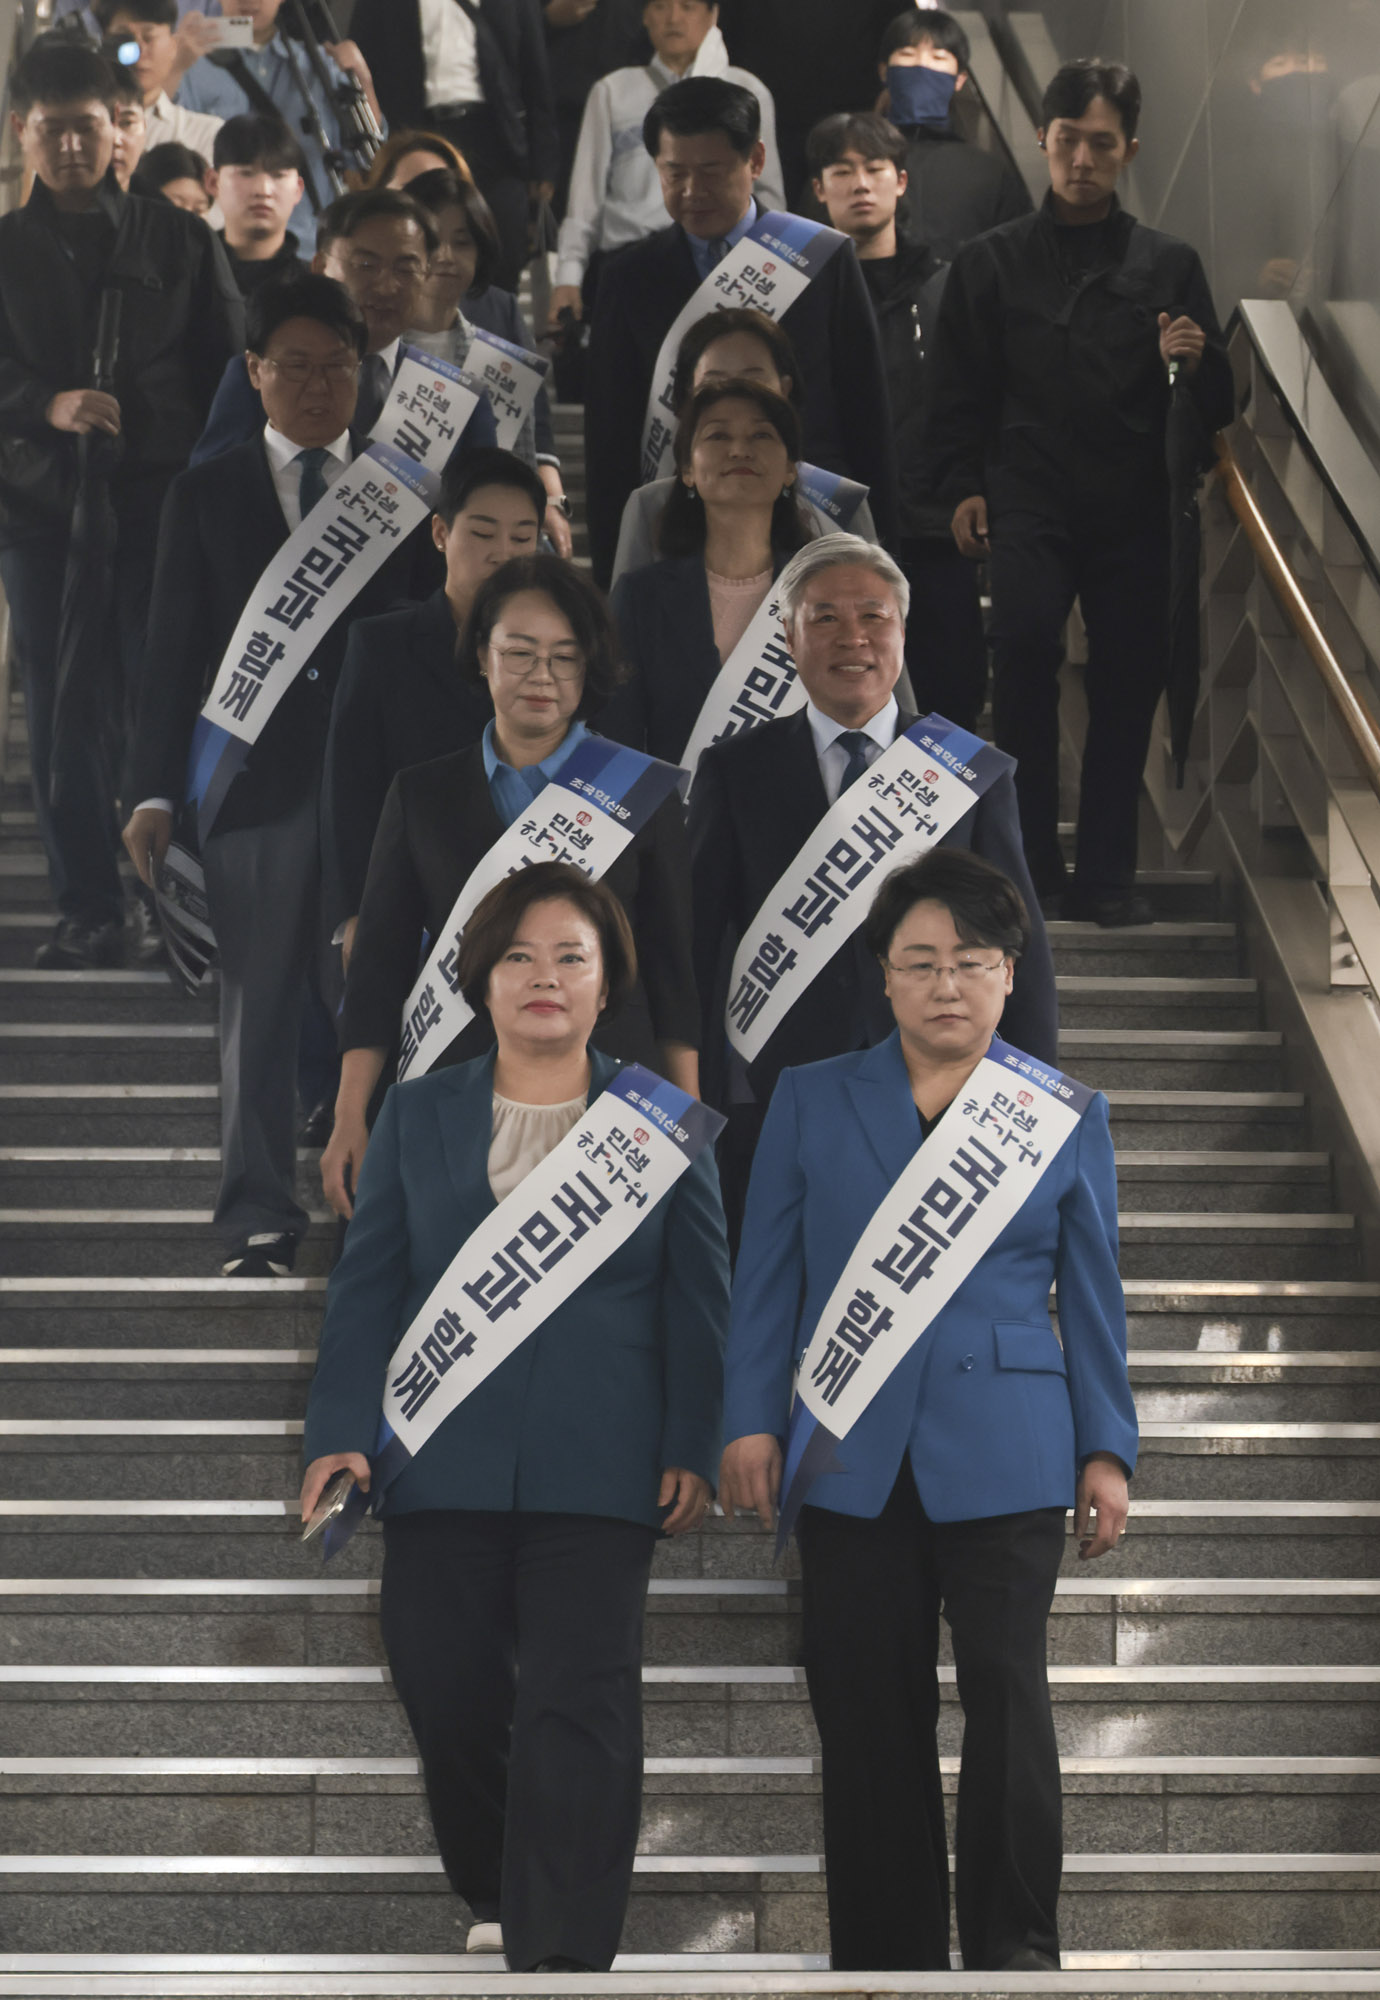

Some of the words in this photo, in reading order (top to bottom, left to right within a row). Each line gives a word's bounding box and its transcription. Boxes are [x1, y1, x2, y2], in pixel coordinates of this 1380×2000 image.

[739, 264, 776, 296] 민생
[415, 383, 451, 414] 민생
[483, 364, 517, 394] 민생
[396, 391, 455, 440] 한가위
[335, 485, 401, 538] 한가위
[361, 481, 400, 514] 민생
[264, 515, 371, 632] 국민과
[218, 630, 286, 722] 함께
[919, 735, 978, 781] 조국혁신당
[569, 777, 632, 820] 조국혁신당
[867, 773, 939, 837] 한가위
[896, 768, 940, 808] 민생
[548, 812, 594, 850] 민생
[781, 805, 904, 939] 국민과
[729, 932, 799, 1035] 함께
[1004, 1054, 1075, 1099] 조국혁신당
[625, 1089, 690, 1143] 조국혁신당
[962, 1098, 1043, 1168] 한가위
[991, 1091, 1038, 1134] 민생
[577, 1130, 649, 1209] 한가위
[605, 1126, 651, 1174] 민생
[871, 1135, 1008, 1295] 국민과
[461, 1170, 614, 1324] 국민과
[391, 1307, 478, 1423] 함께
[810, 1287, 895, 1407] 함께
